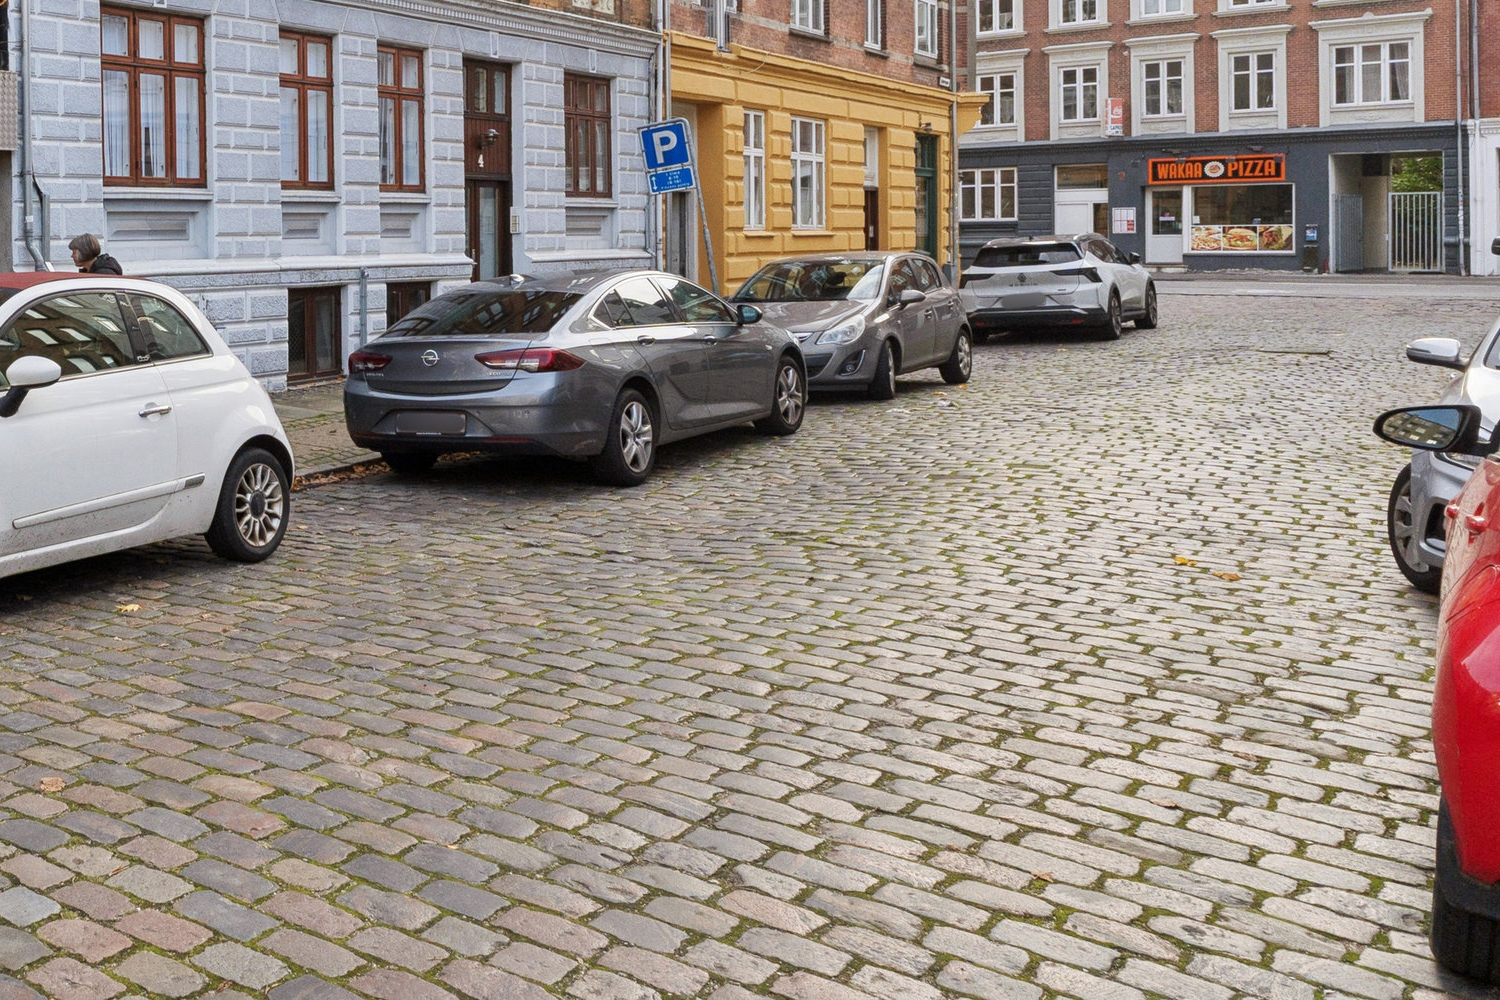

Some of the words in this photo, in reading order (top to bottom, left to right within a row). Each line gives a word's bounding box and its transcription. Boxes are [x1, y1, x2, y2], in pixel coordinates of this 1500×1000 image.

[652, 130, 677, 164] P
[478, 154, 484, 168] 4
[1157, 162, 1202, 179] WAKAA
[1227, 160, 1276, 177] PIZZA
